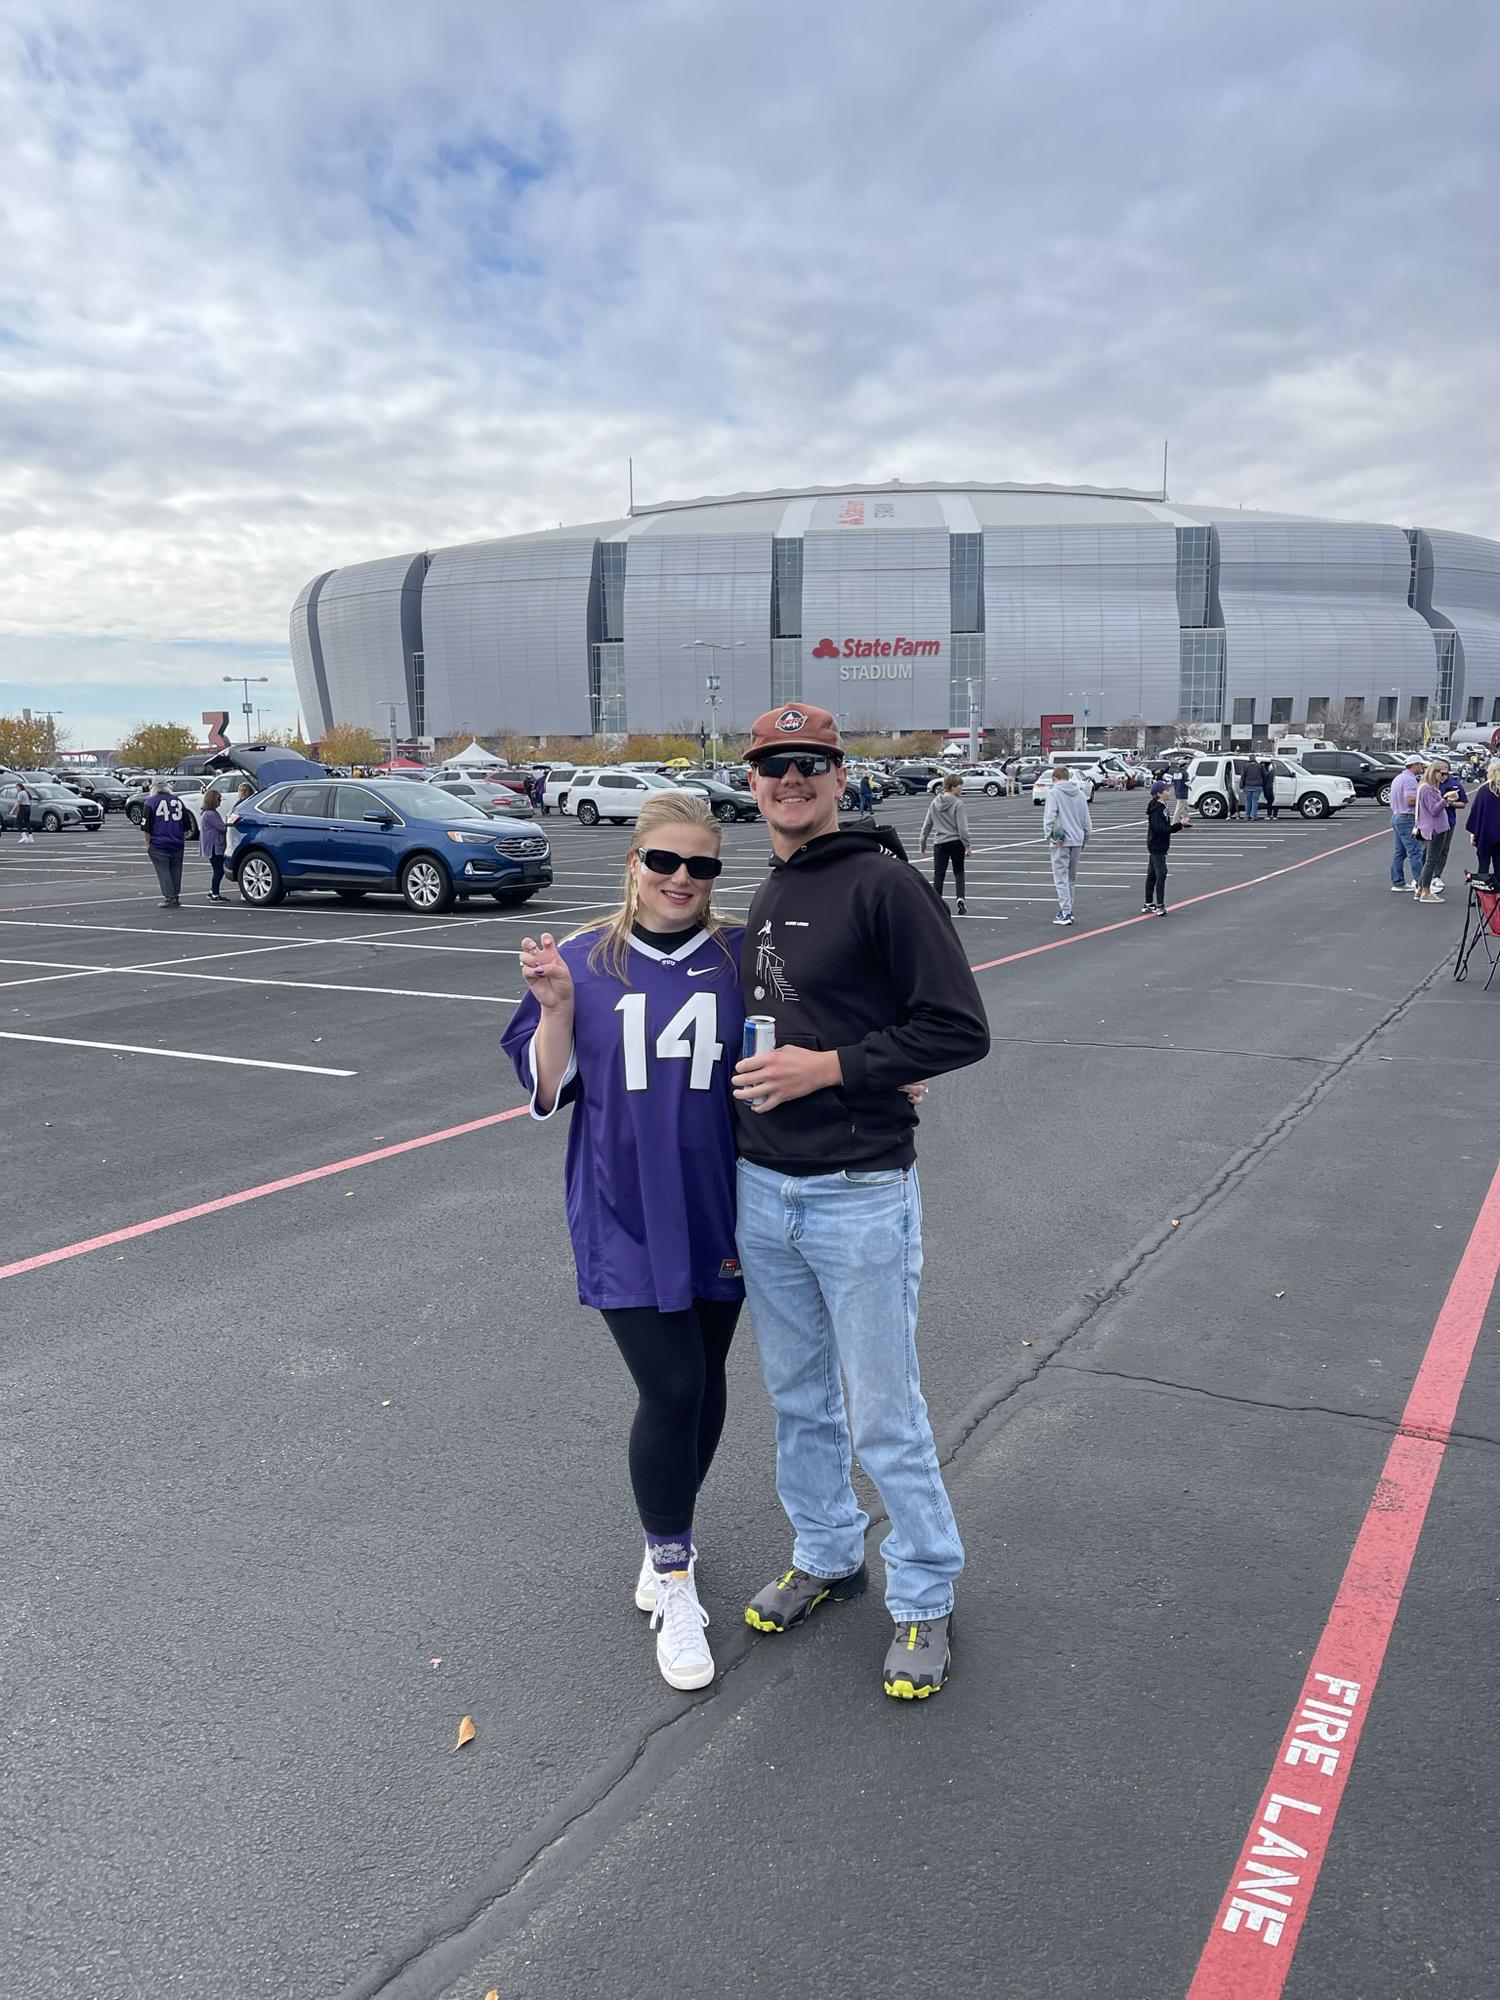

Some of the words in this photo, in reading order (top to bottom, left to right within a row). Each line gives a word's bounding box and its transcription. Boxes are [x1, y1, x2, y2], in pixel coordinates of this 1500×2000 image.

[839, 664, 913, 681] STADIUM
[155, 799, 183, 822] 43
[614, 991, 724, 1091] 14
[1284, 1672, 1361, 1777] FIRE
[1222, 1793, 1322, 1947] LANE
